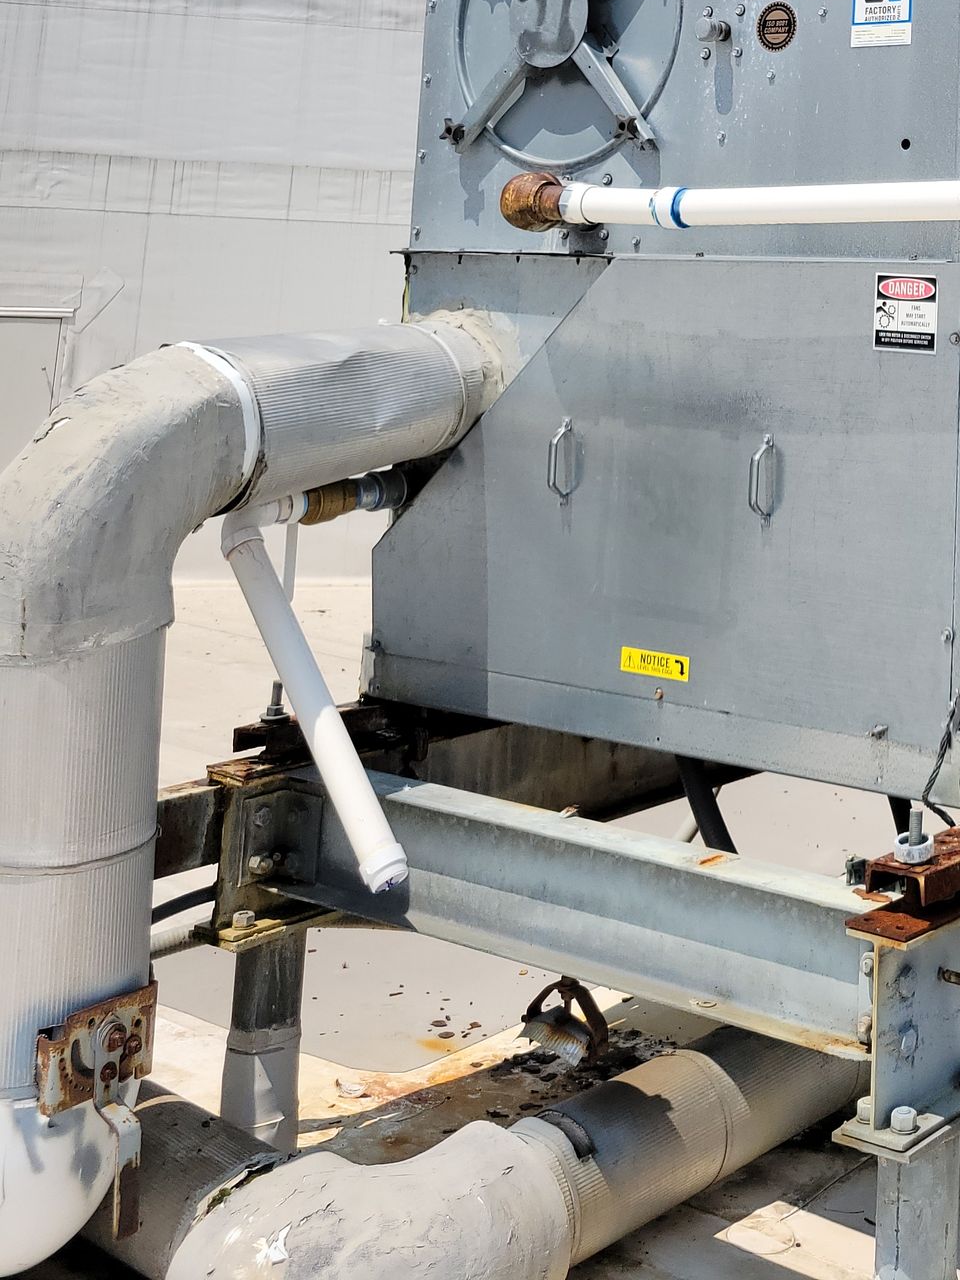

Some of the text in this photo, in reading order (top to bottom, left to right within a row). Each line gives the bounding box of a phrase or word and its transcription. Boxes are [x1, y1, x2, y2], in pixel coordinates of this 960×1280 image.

[864, 5, 897, 15] FACTORY
[864, 14, 896, 22] AUTHORIZED
[888, 282, 925, 296] DANGER
[640, 653, 670, 668] NOTICE
